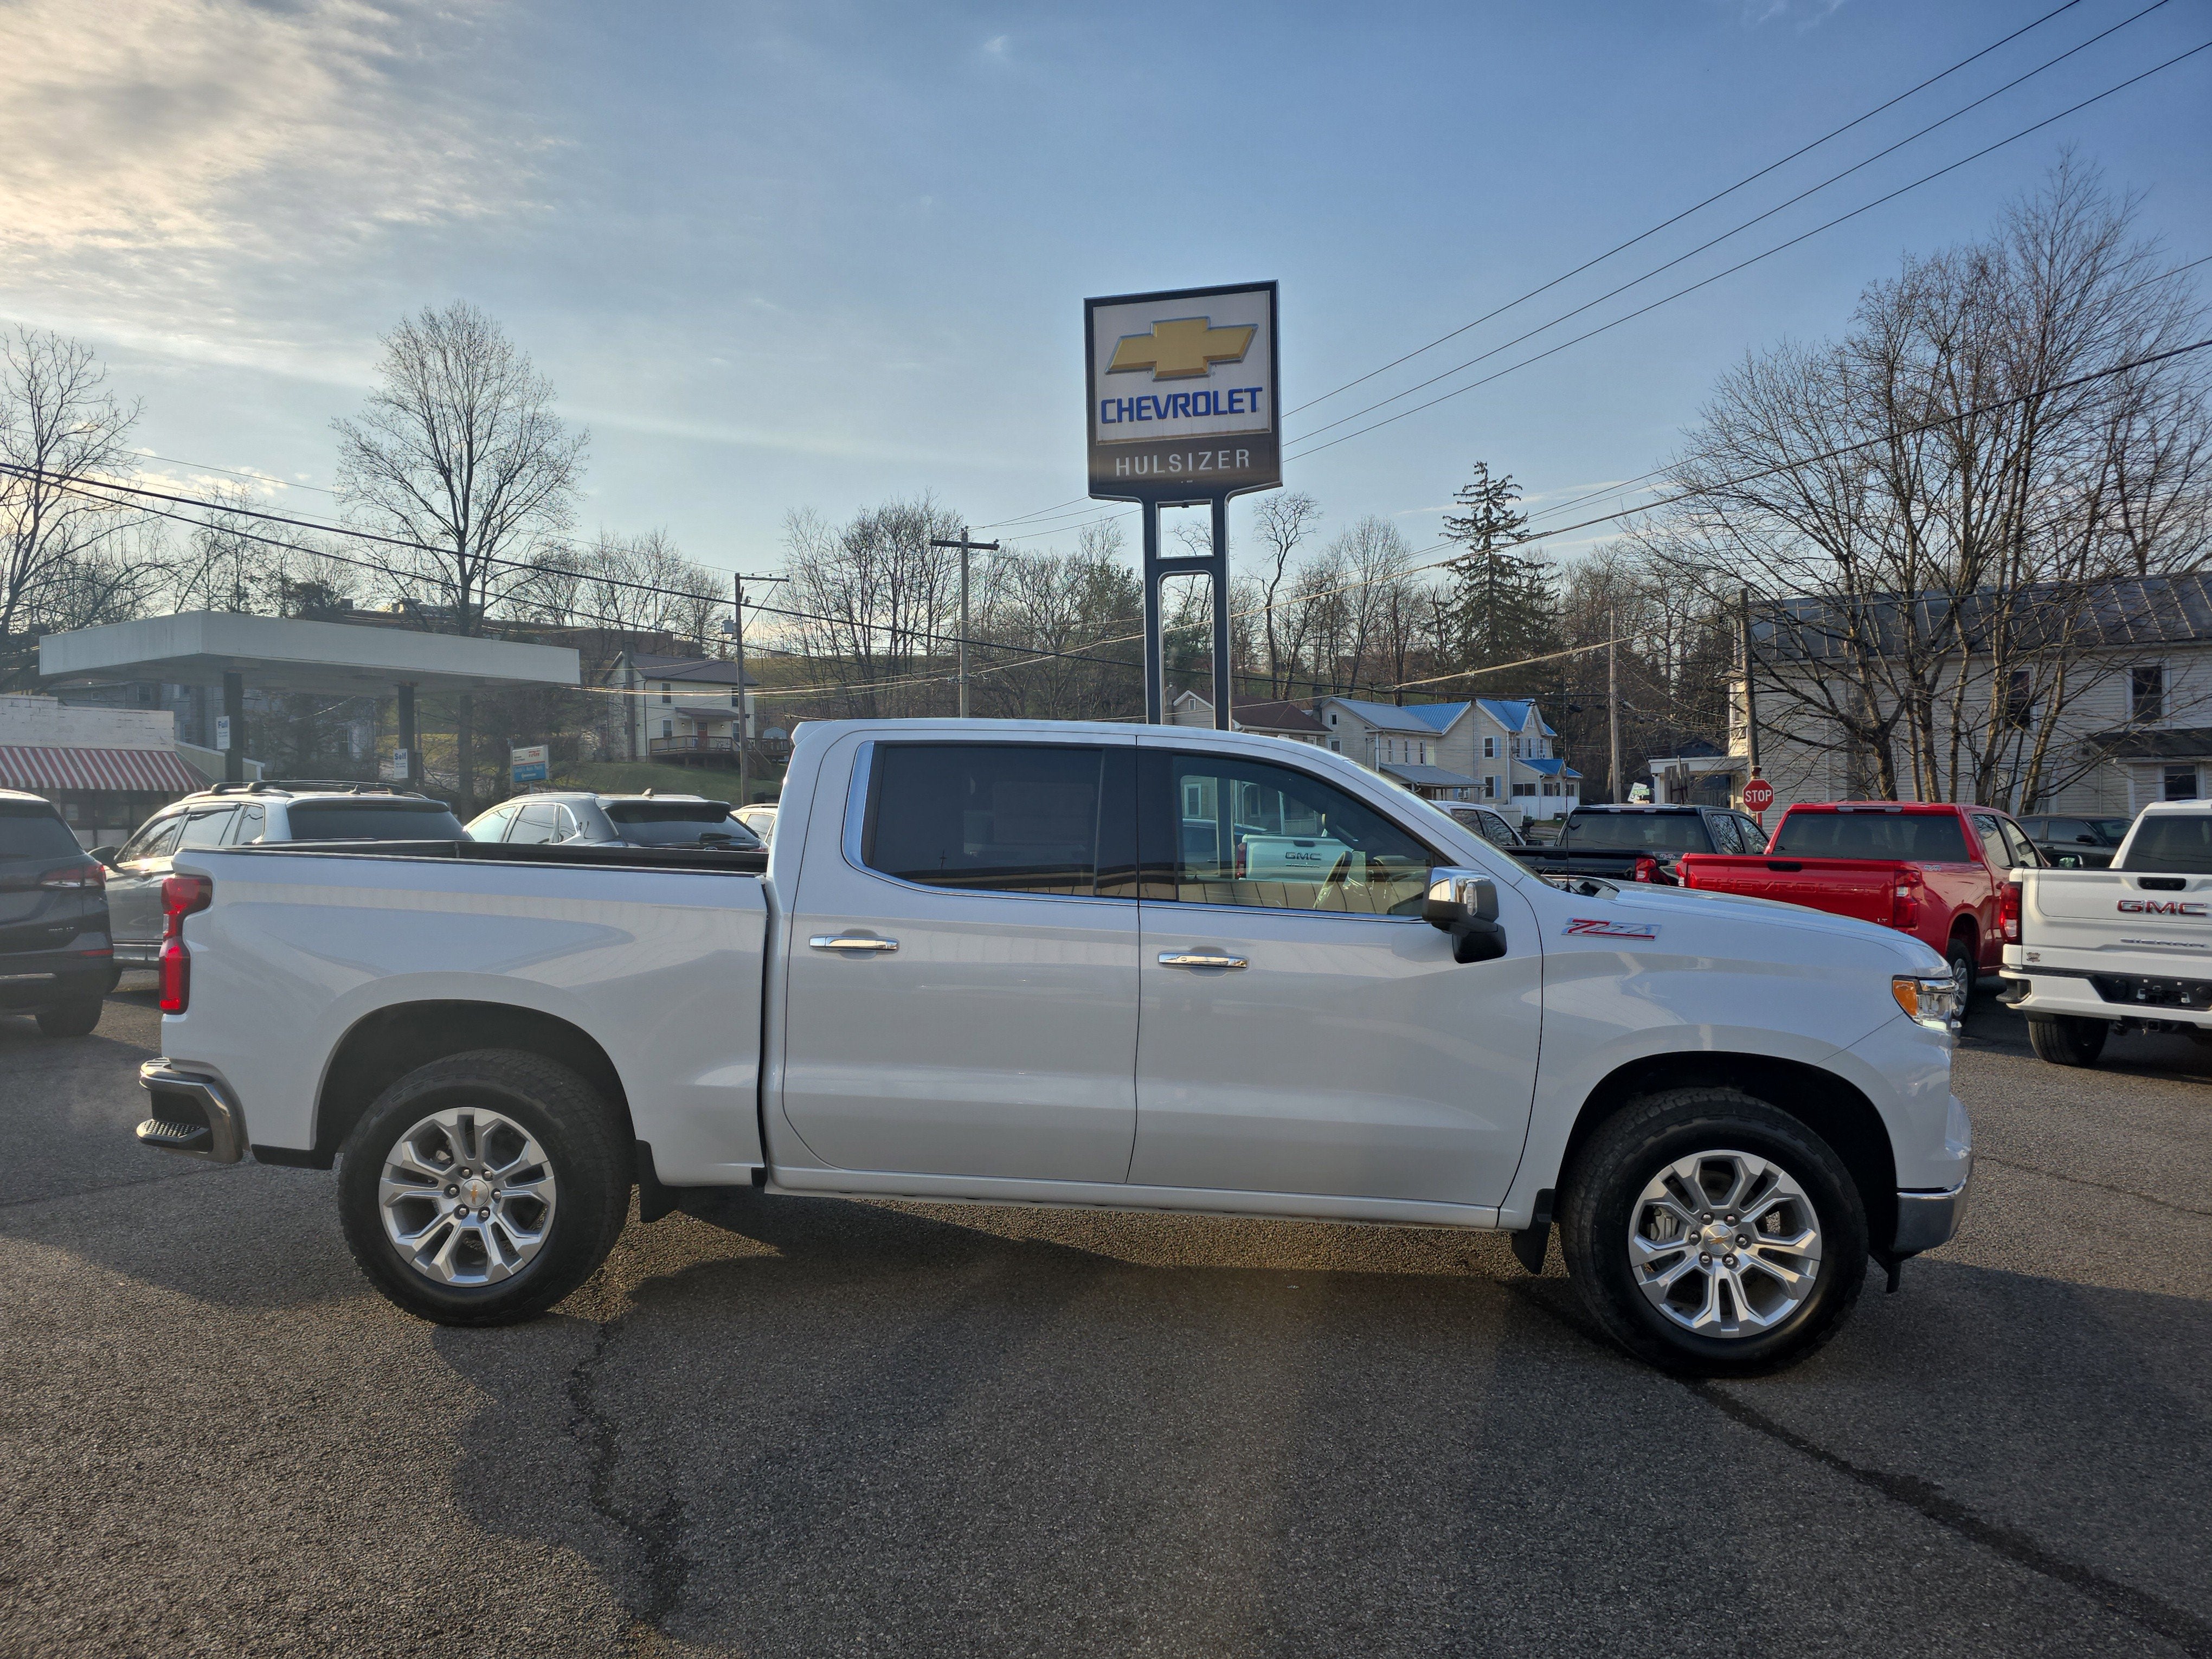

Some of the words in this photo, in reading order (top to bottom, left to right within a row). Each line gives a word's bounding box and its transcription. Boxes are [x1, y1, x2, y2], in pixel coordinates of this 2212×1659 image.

[1101, 387, 1263, 423] CHEVROLET
[1116, 449, 1250, 477] HULSIZER
[1745, 790, 1772, 802] STOP
[2117, 900, 2207, 916] GMC
[1561, 918, 1663, 941] Z71
[2120, 938, 2208, 948] SIERRA
